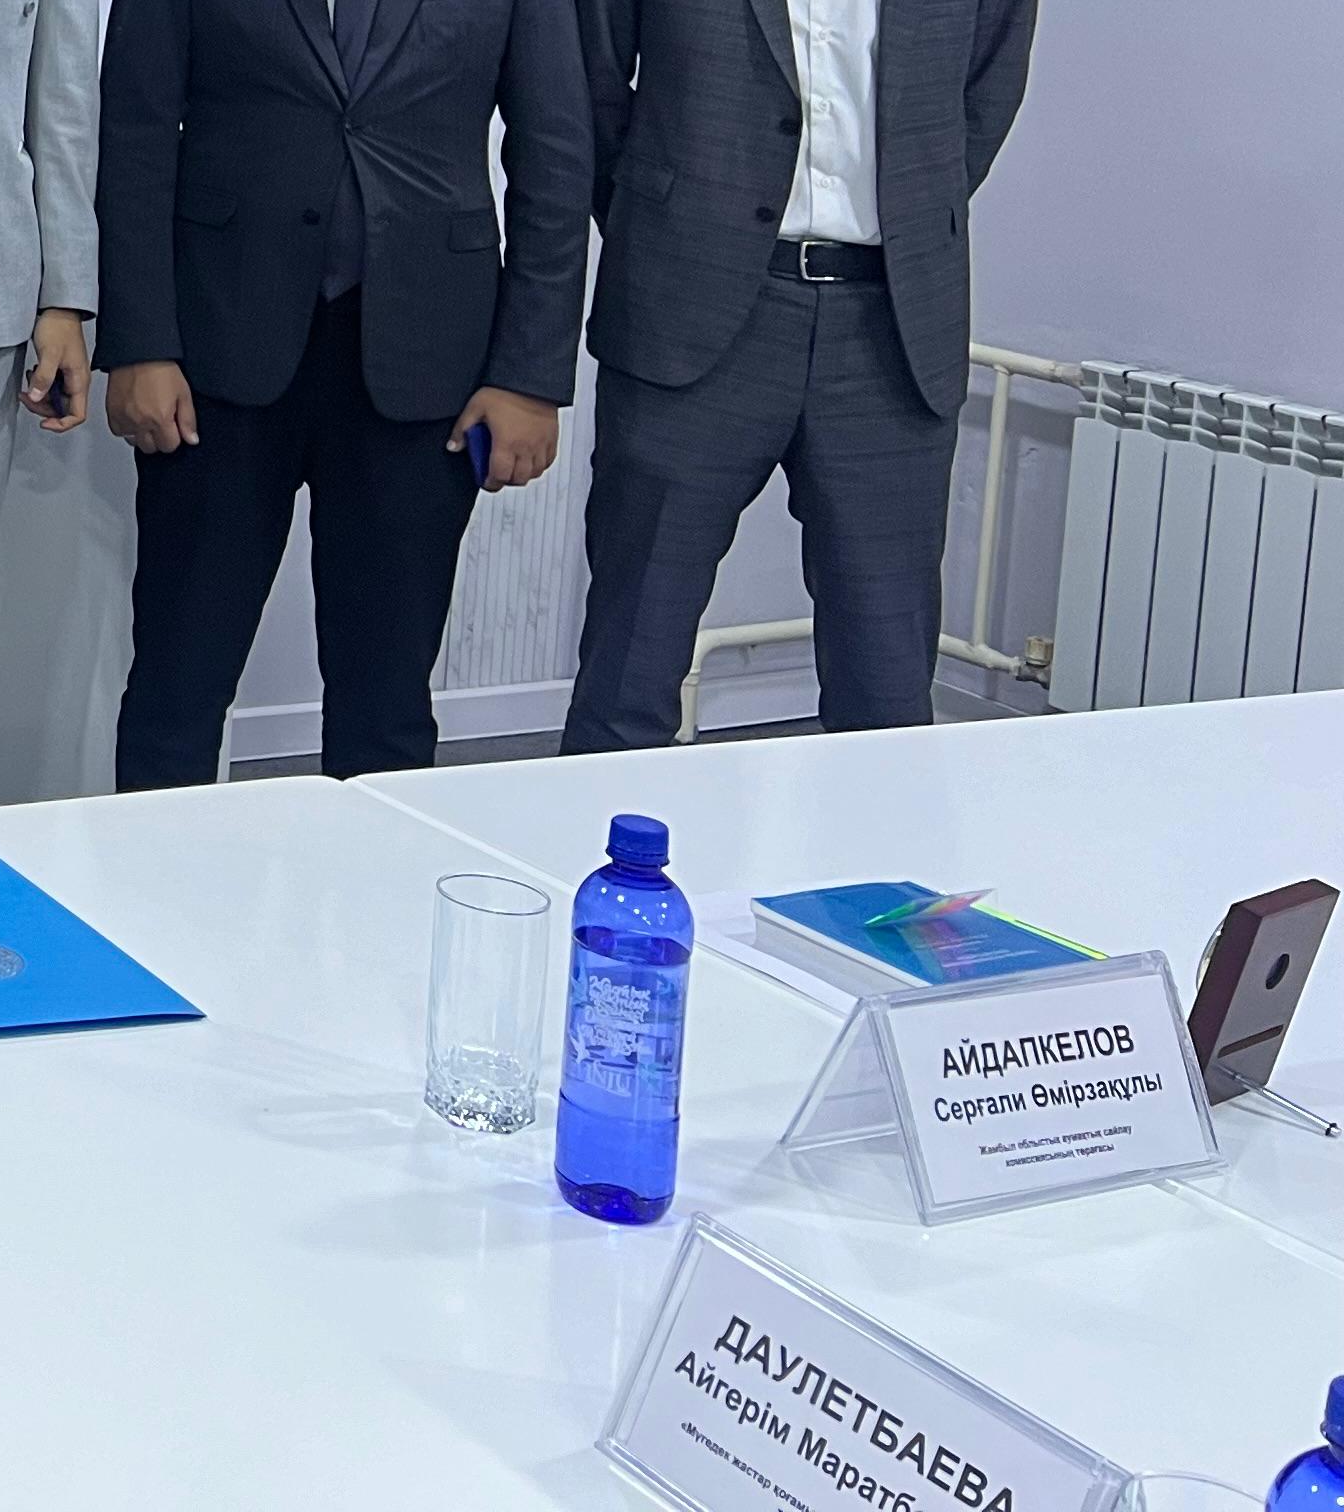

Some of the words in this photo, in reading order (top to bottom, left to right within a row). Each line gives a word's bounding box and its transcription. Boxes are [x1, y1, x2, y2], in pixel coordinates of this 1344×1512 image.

[943, 1024, 1135, 1079] АЙДАПКЕЛОВ
[934, 1092, 1027, 1125] Серғали
[1031, 1073, 1163, 1109] Өмірзақұлы
[674, 1350, 792, 1445] Айгерім
[713, 1314, 1013, 1512] ДАУЛЕТБАЕВА
[731, 1455, 771, 1489] жастар
